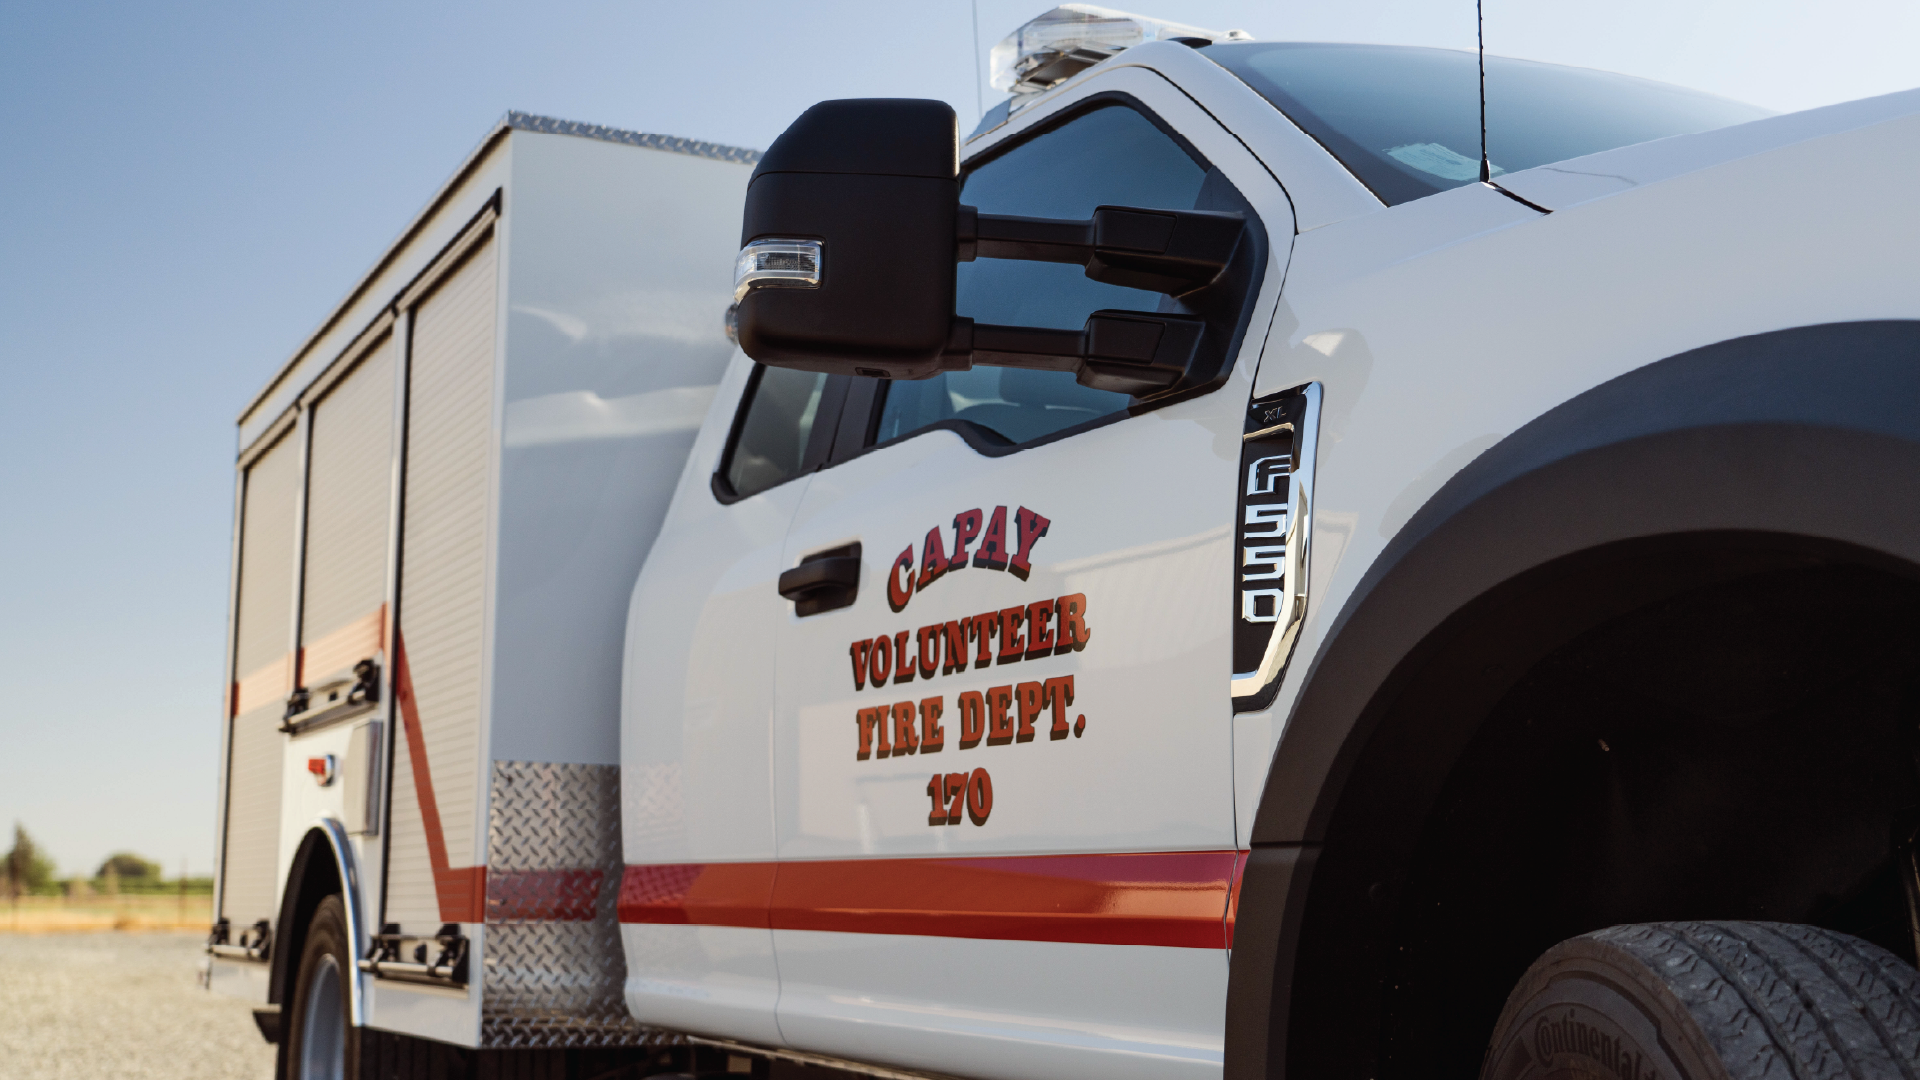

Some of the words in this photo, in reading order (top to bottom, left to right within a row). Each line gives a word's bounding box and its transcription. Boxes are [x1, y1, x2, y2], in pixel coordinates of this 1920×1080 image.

[1264, 406, 1287, 423] XL
[887, 505, 1051, 613] CAPAY
[850, 593, 1091, 691] VOLUNTEER
[856, 695, 944, 761] FIRE
[958, 674, 1086, 750] DEPT.
[927, 767, 993, 827] 170
[1534, 1009, 1643, 1080] Continental
